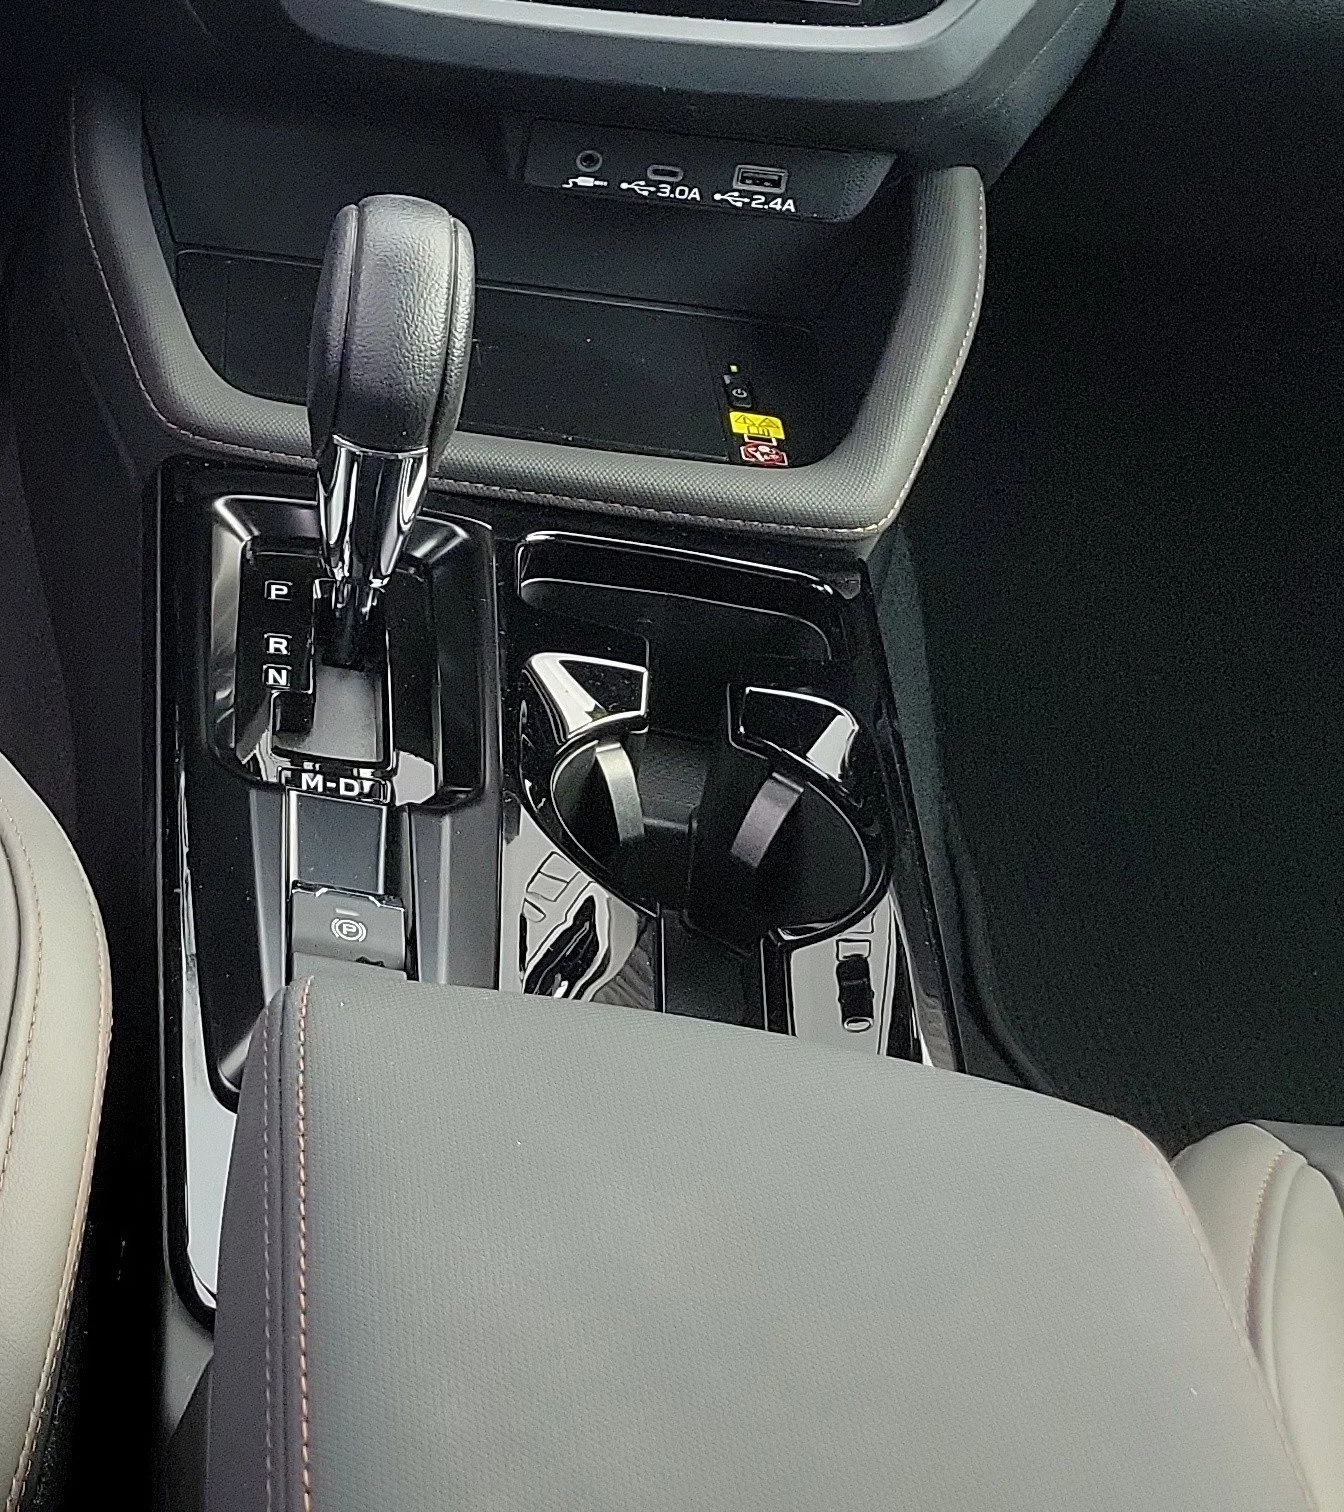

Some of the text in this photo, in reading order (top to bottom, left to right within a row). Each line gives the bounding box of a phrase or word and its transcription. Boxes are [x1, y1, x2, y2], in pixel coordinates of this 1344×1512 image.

[657, 184, 701, 201] 3.0A
[750, 195, 796, 213] 2.4A
[269, 584, 289, 599] P
[268, 637, 289, 655] R
[267, 668, 288, 686] N
